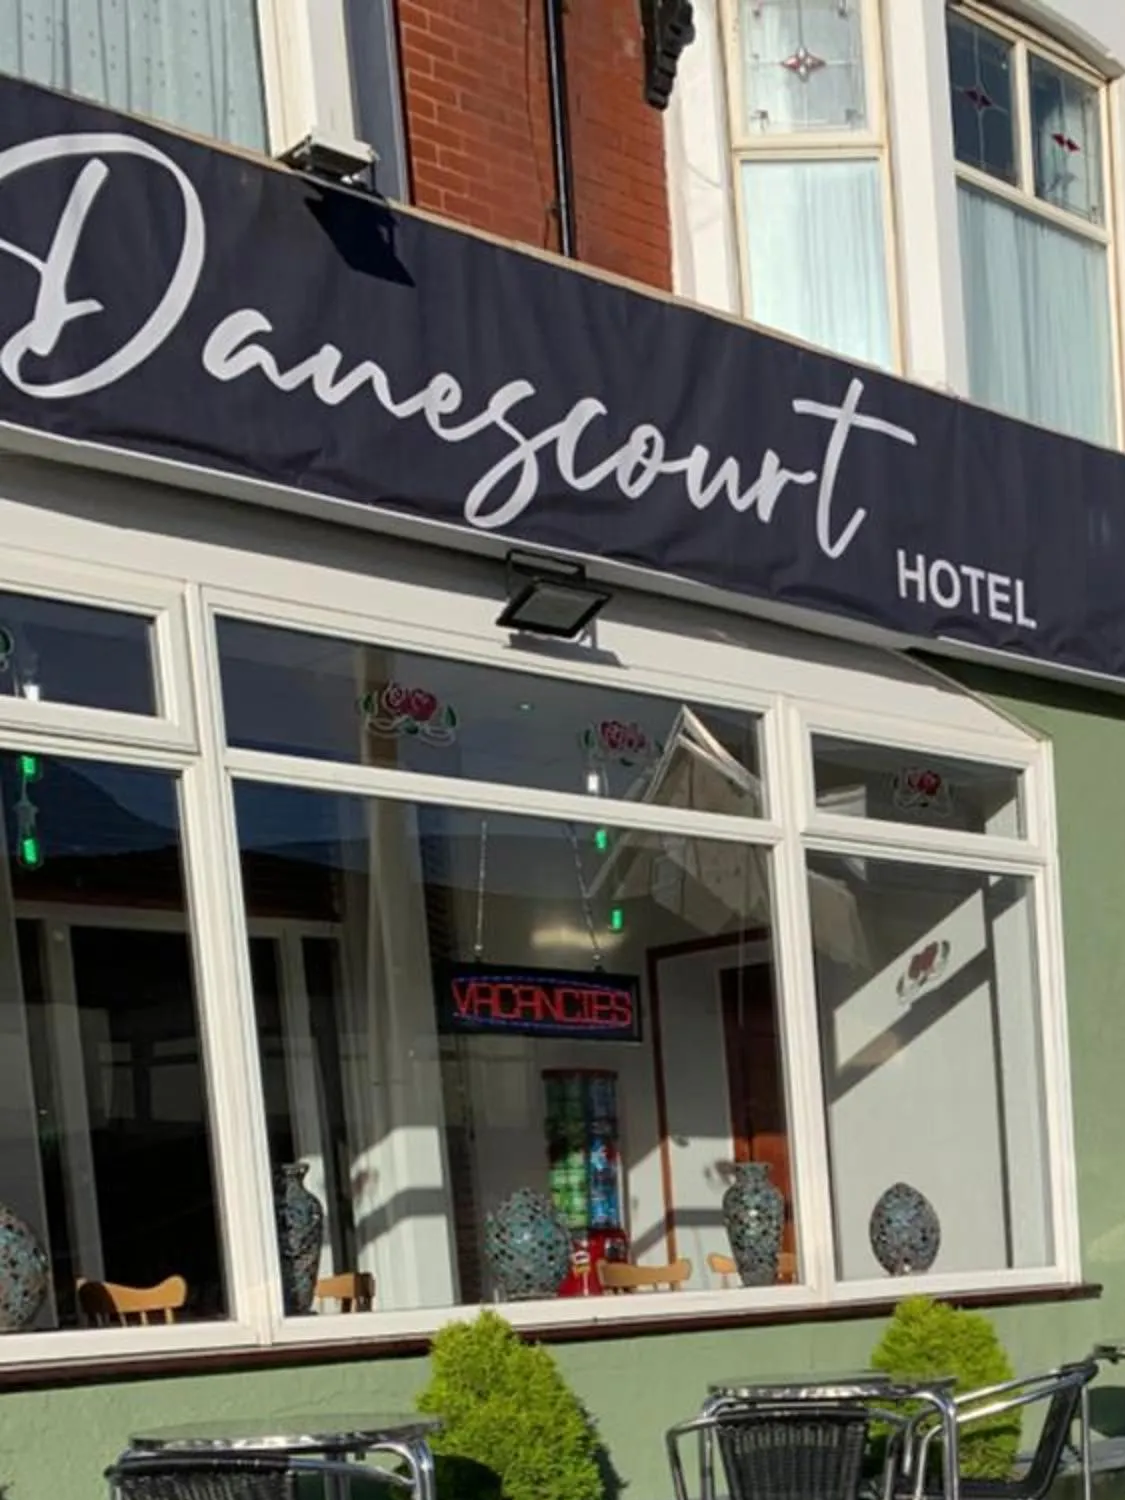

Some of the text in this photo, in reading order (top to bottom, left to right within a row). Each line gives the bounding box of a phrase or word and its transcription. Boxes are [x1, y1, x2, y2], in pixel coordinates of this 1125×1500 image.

[0, 133, 916, 559] Danescourt
[897, 548, 1037, 630] HOTEL
[452, 979, 632, 1027] VACANCIES
